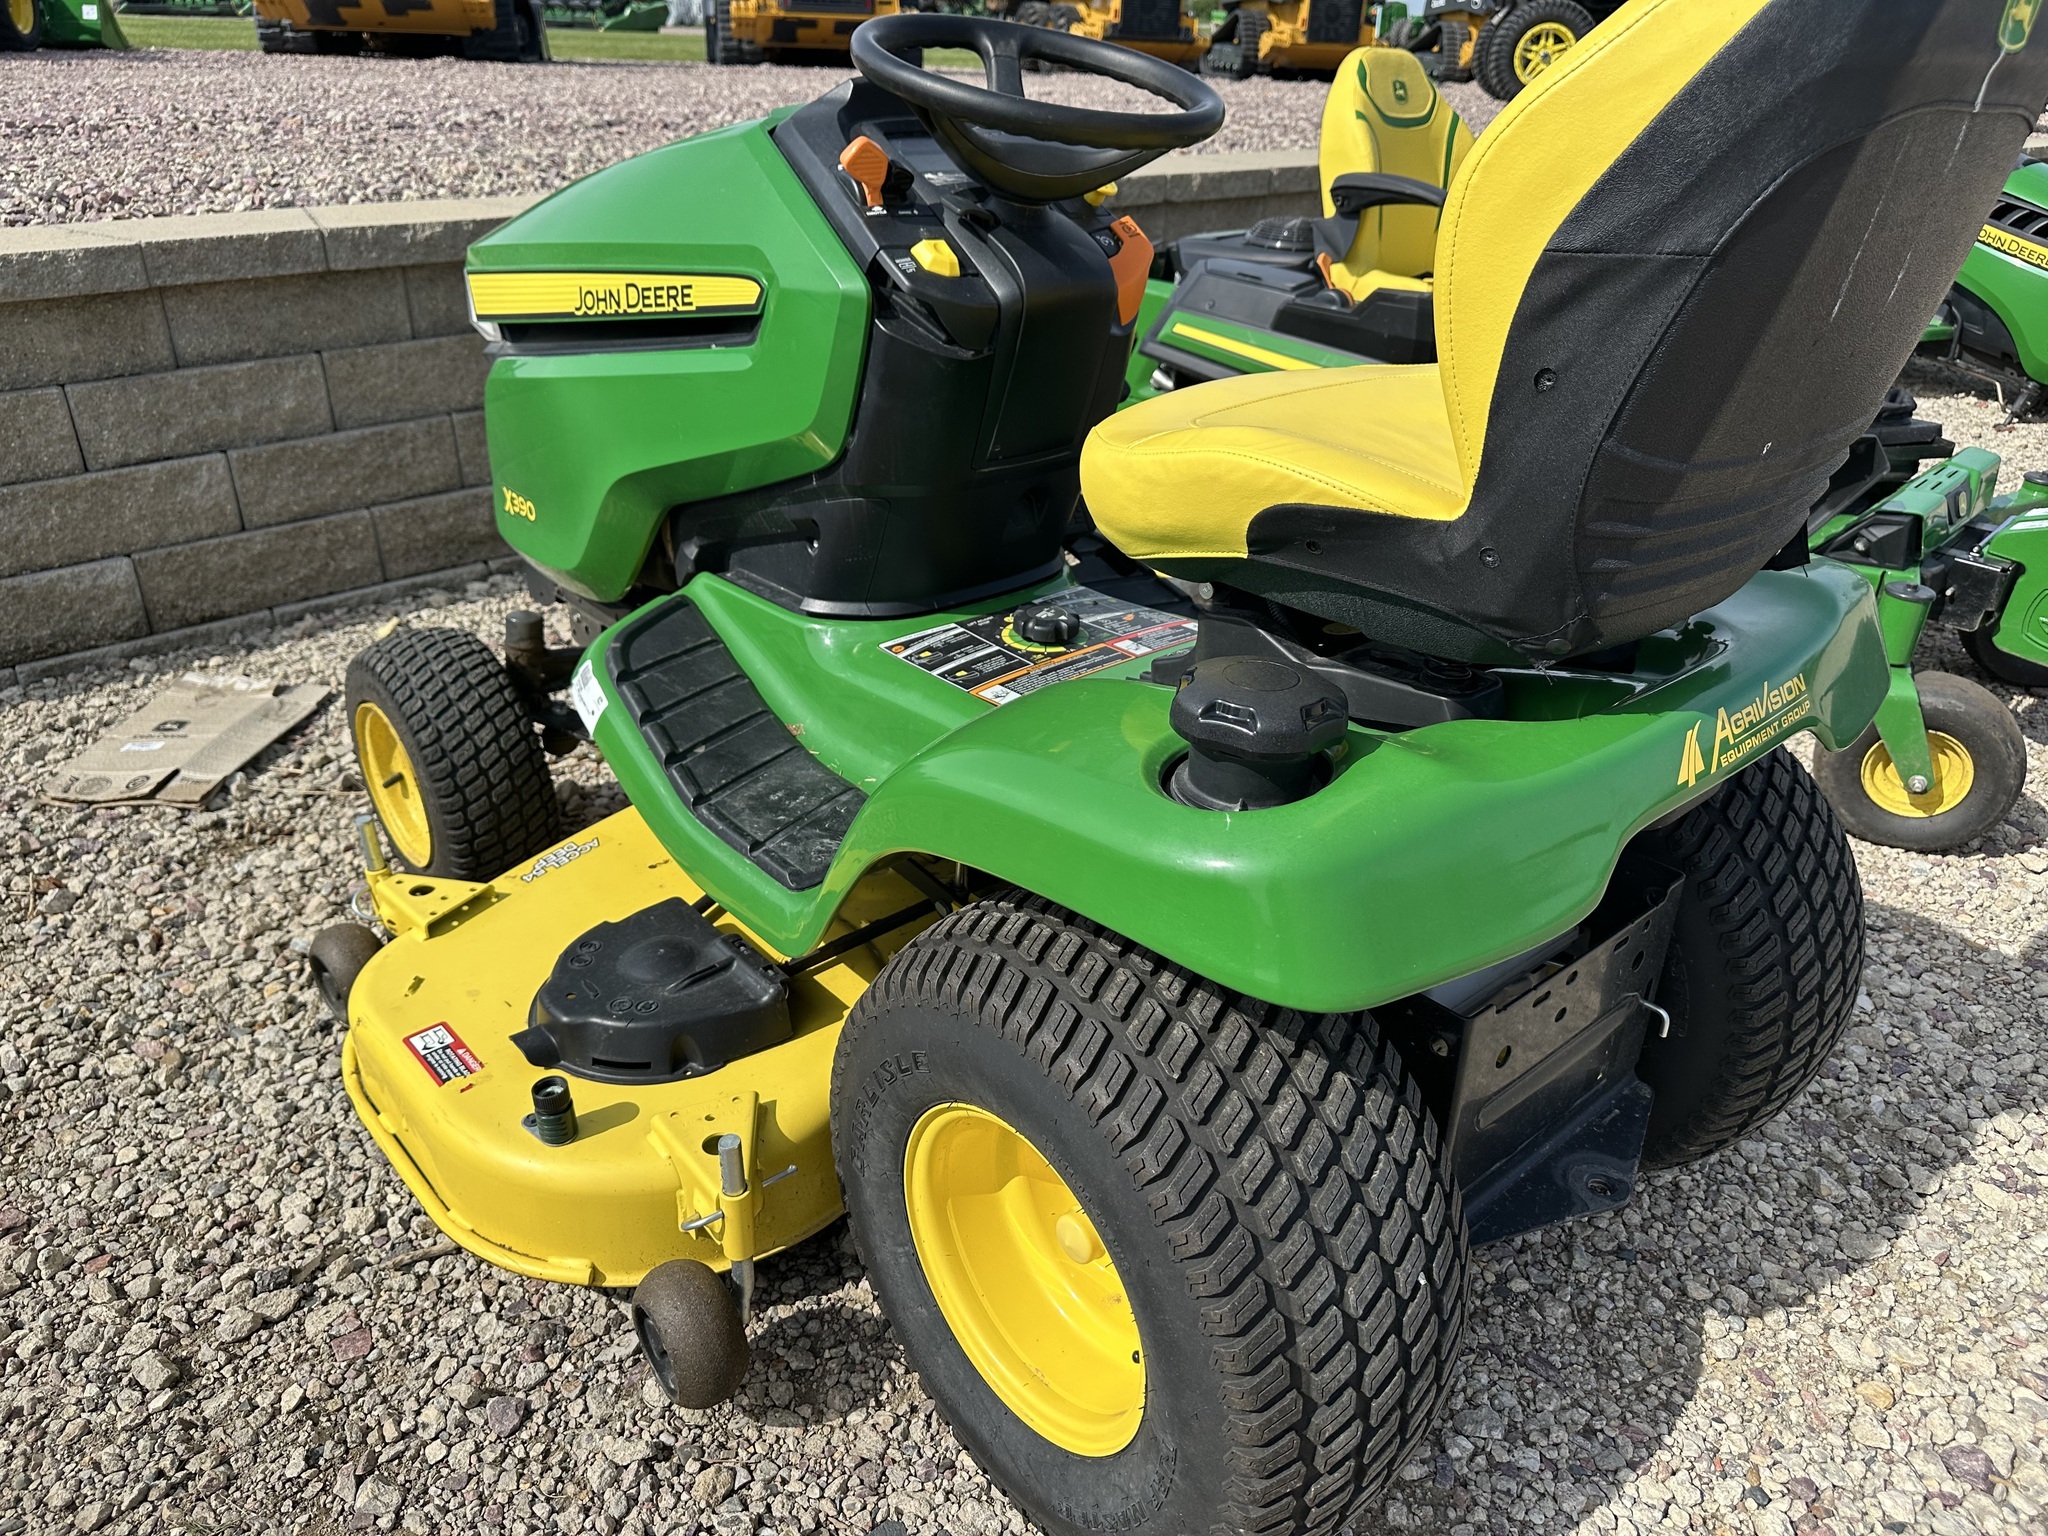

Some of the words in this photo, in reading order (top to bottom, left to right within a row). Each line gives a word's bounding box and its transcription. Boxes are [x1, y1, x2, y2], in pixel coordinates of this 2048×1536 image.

[1978, 229, 2007, 248] OHN
[575, 286, 621, 312] JOHN
[625, 283, 694, 309] DEERE
[502, 484, 536, 522] X390
[1720, 721, 1780, 767] EQUIPMENT
[1782, 700, 1811, 727] GROUP
[533, 841, 578, 870] DEEP
[545, 837, 600, 869] ACCEL
[462, 1051, 482, 1072] DANGER
